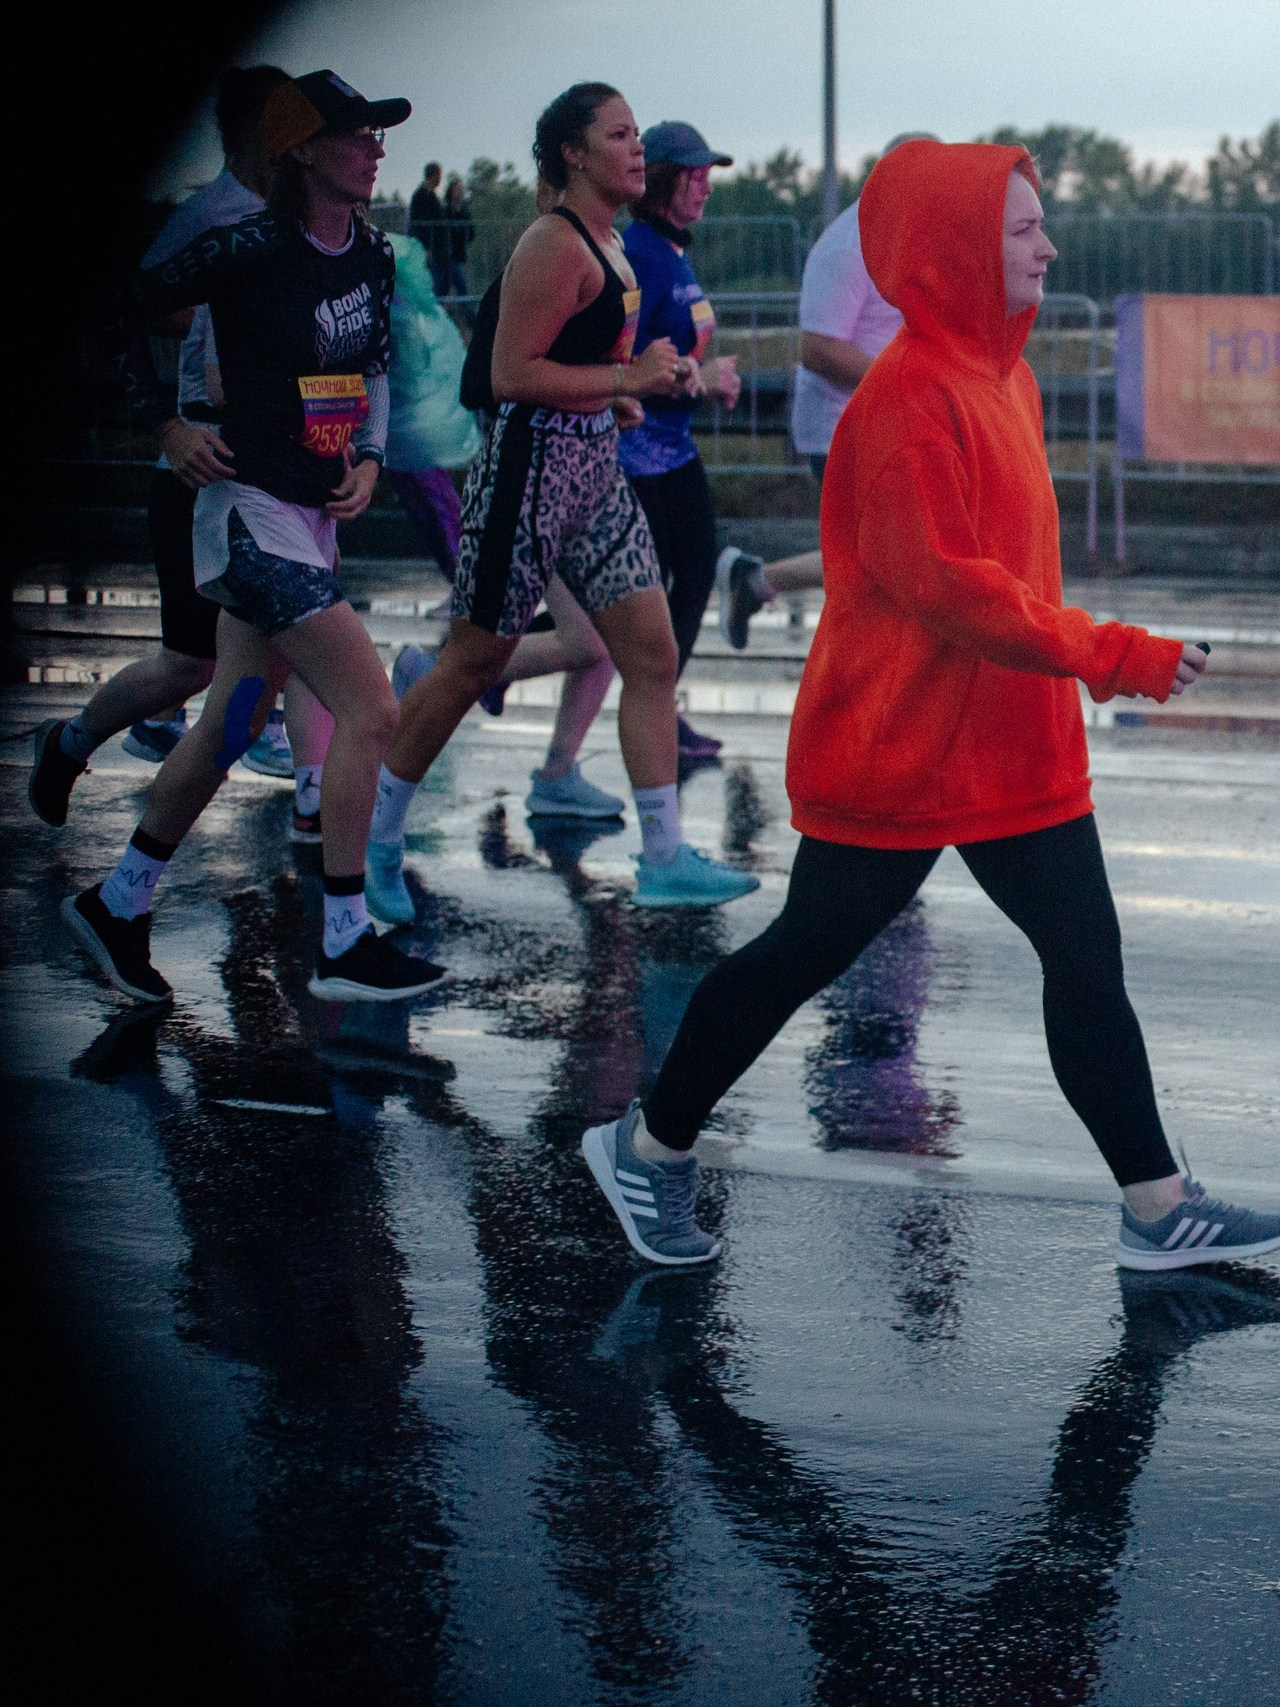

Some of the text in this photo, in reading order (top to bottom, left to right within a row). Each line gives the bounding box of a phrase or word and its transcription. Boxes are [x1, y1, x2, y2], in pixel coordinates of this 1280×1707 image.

[331, 282, 372, 316] BONA
[337, 307, 373, 336] FIDE
[302, 422, 351, 453] 2530
